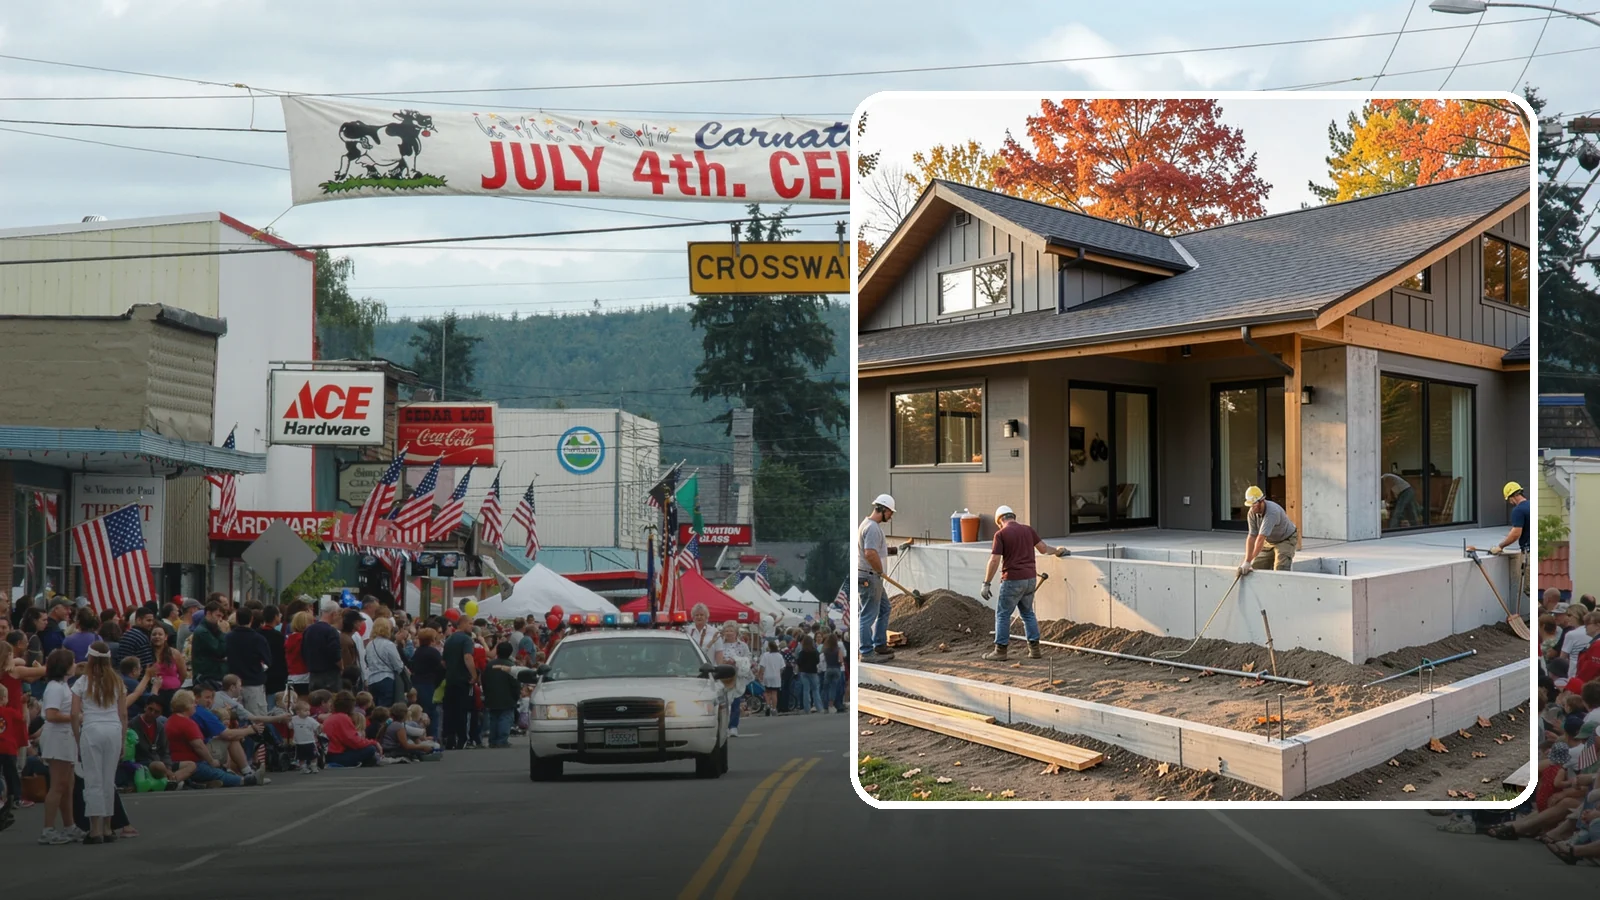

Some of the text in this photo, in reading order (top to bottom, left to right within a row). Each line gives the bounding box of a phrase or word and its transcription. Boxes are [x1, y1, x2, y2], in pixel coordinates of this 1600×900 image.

[695, 121, 850, 149] Carnat
[481, 141, 605, 192] JULY
[632, 150, 746, 198] 4th.
[697, 254, 850, 280] CROSSWA
[283, 380, 373, 419] ACE
[406, 409, 452, 422] CEDAR
[284, 421, 370, 436] Hardware
[354, 467, 385, 479] Simpl
[95, 485, 124, 494] Vincent
[126, 485, 136, 494] de
[138, 486, 155, 495] Paul
[81, 503, 153, 521] THRT
[688, 526, 741, 535] CRNATION
[699, 535, 730, 543] GLASS
